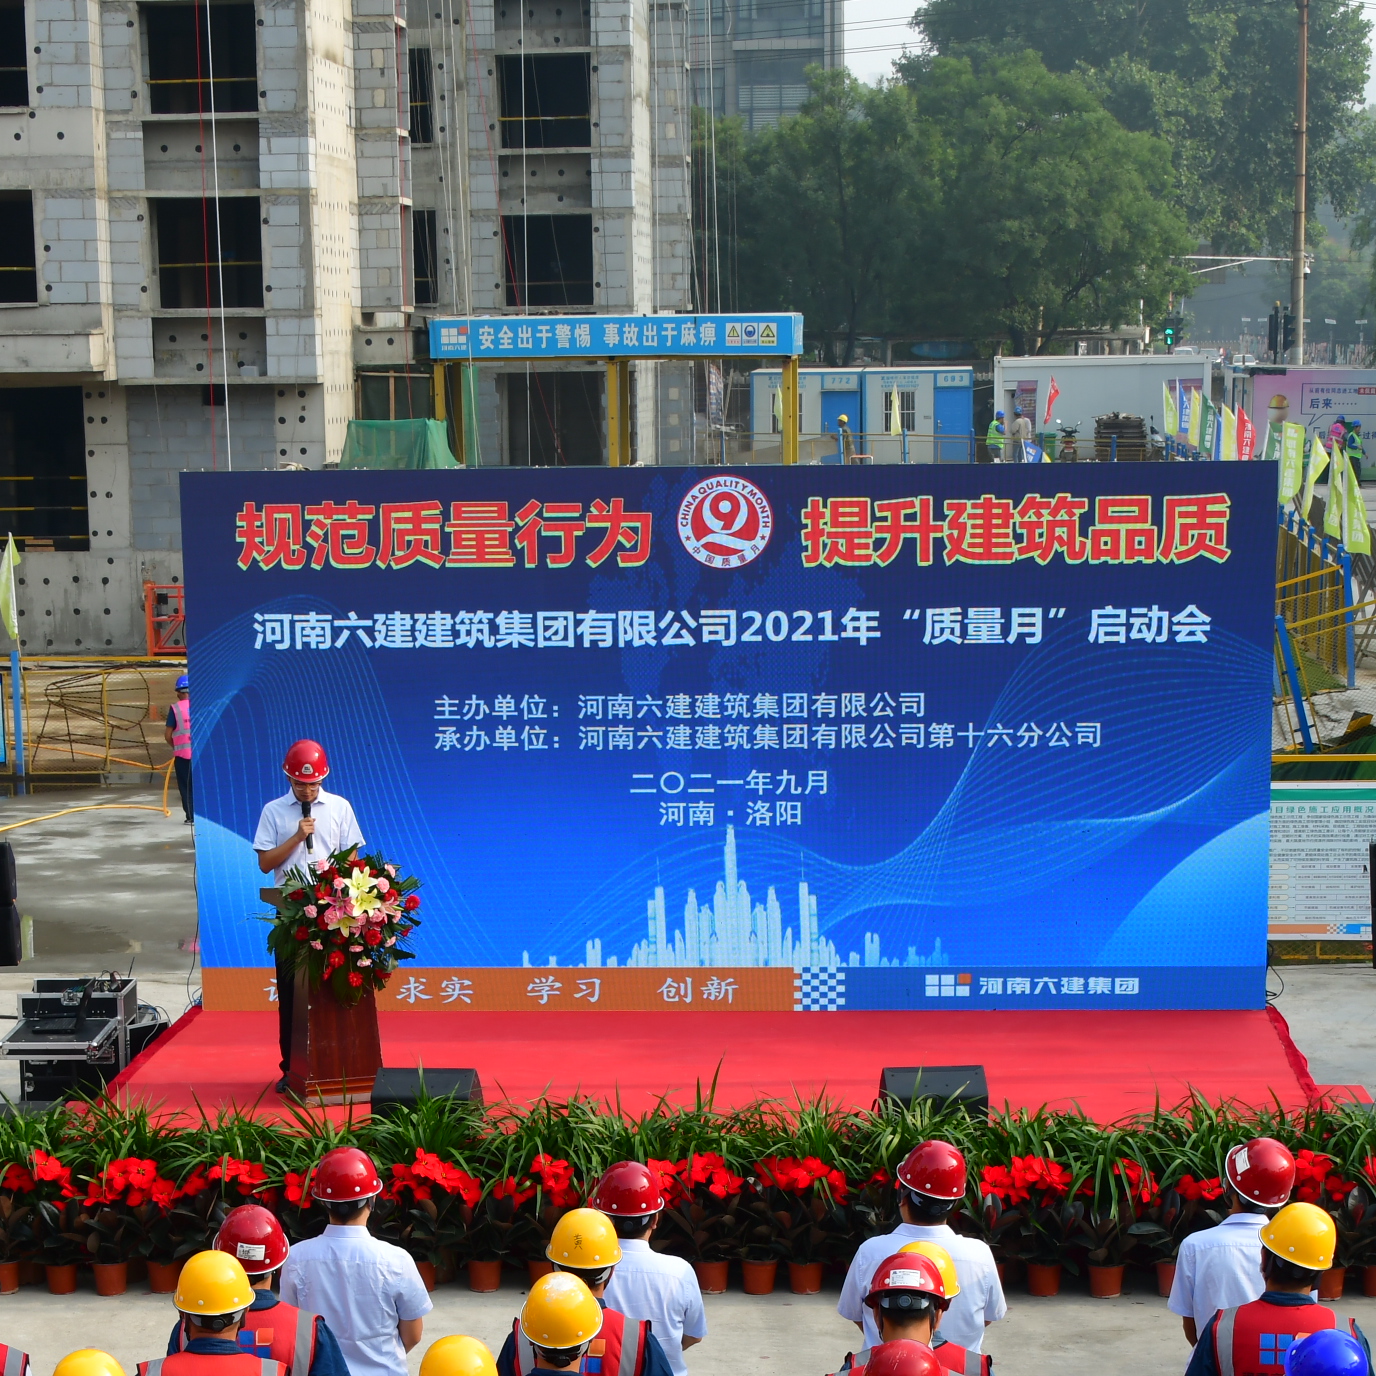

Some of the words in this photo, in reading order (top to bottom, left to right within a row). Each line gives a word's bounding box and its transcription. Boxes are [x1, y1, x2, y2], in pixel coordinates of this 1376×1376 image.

[479, 323, 591, 349] 安全出于警惕
[602, 322, 717, 347] 事故出于麻痹
[831, 376, 851, 384] 772
[235, 498, 653, 570] 规范质量行为
[800, 493, 1233, 567] 提升建筑品质
[1270, 806, 1375, 814] 目绿色施工应用概况
[396, 975, 475, 1004] 求实
[525, 975, 603, 1003] 学习
[656, 975, 740, 1003] 创新
[979, 976, 1140, 995] 河南六建集团
